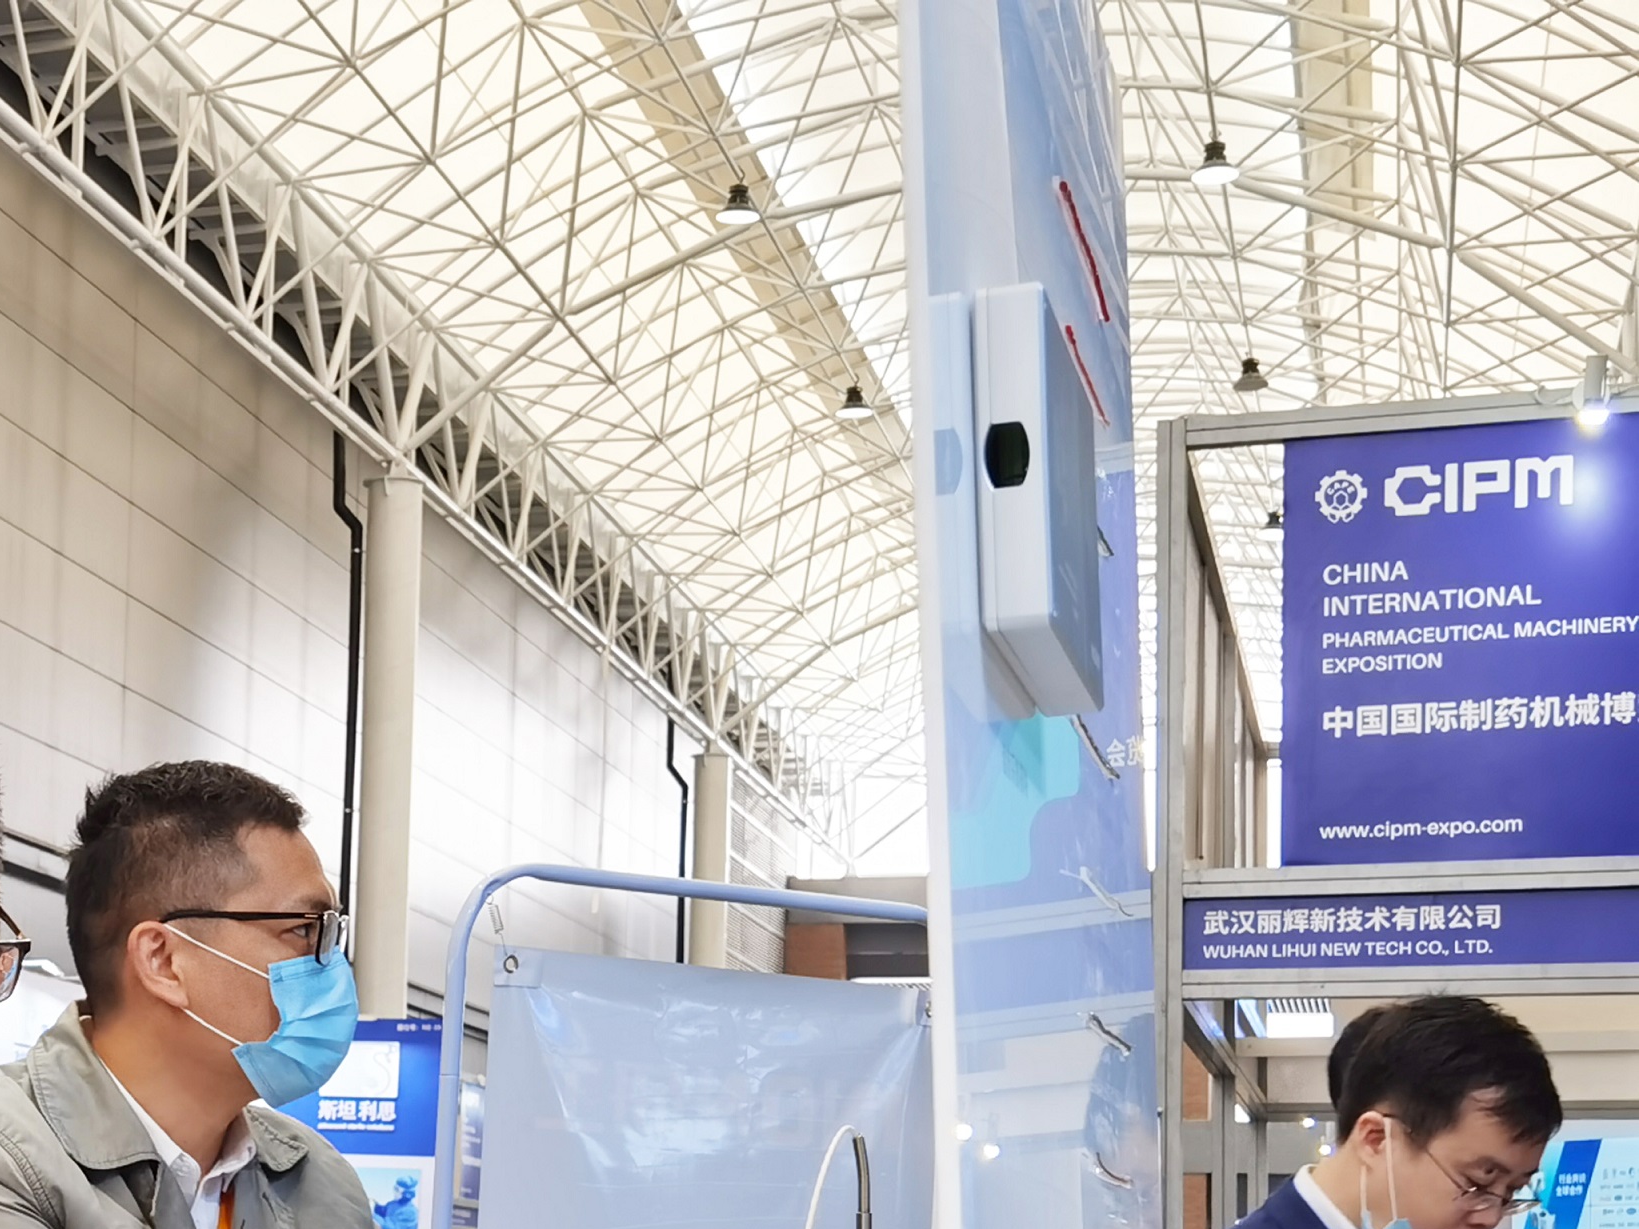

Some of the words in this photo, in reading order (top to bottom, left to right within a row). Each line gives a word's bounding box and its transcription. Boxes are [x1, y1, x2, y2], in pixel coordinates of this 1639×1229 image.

[1384, 454, 1574, 517] CIPM
[1322, 560, 1409, 586] CHINA
[1323, 584, 1542, 617] INTERNATIONAL
[1322, 623, 1510, 650] PHARMACEUTICAL
[1514, 615, 1639, 638] MACHINERY
[1322, 652, 1443, 675] EXPOSITION
[1322, 690, 1637, 739] 中国国际制药机械博
[1319, 818, 1523, 841] www.cipm-expo.com
[1203, 904, 1502, 936] 武汉丽辉新技术有限公司
[1203, 943, 1268, 960] WUHAN
[1271, 942, 1317, 959] LIHUI
[1320, 941, 1362, 958] NEW
[1364, 940, 1413, 957] TECH
[1454, 939, 1493, 955] LTD.
